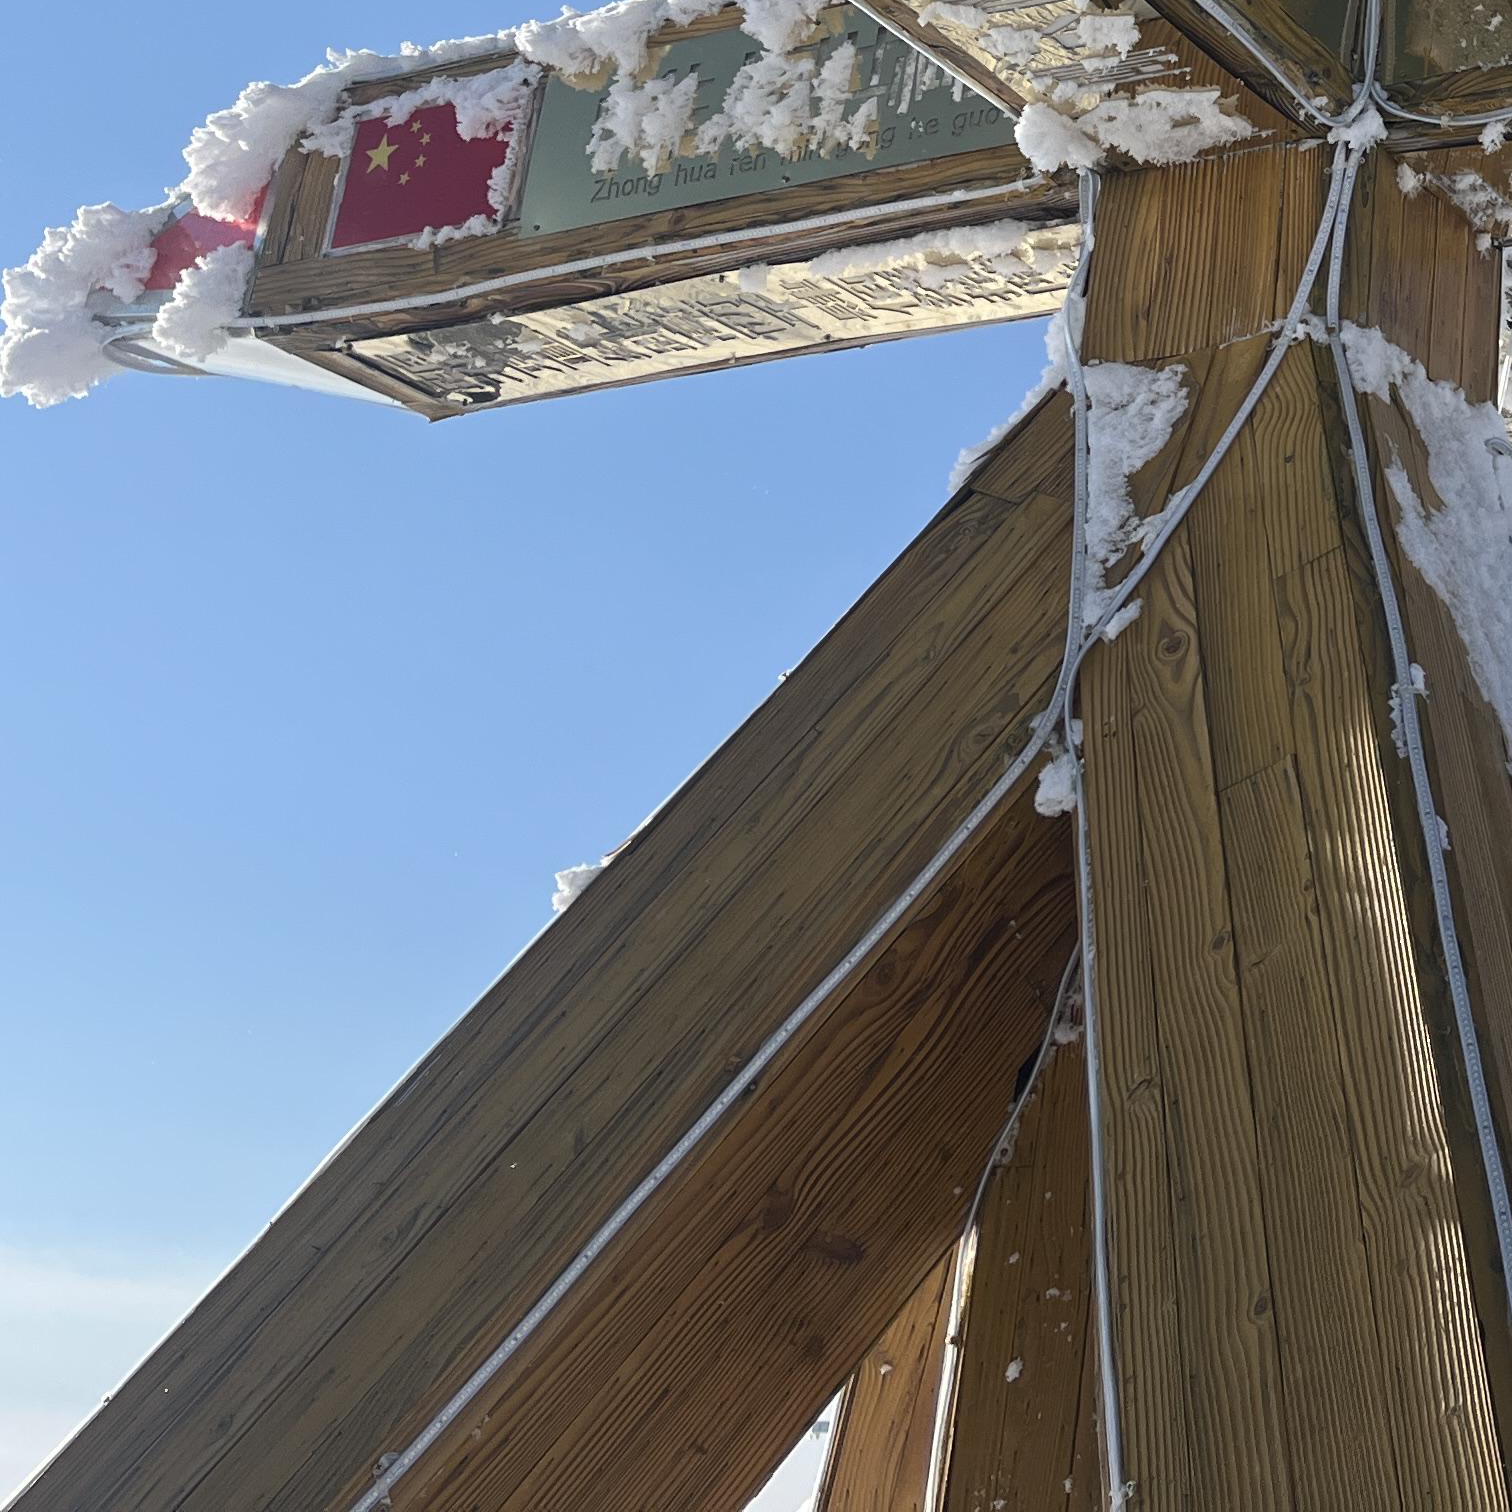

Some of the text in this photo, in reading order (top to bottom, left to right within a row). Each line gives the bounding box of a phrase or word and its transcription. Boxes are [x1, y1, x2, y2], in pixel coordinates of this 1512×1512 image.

[590, 173, 664, 204] Zhong
[674, 163, 719, 186] hua
[728, 151, 767, 177] ren
[951, 106, 1001, 137] guo
